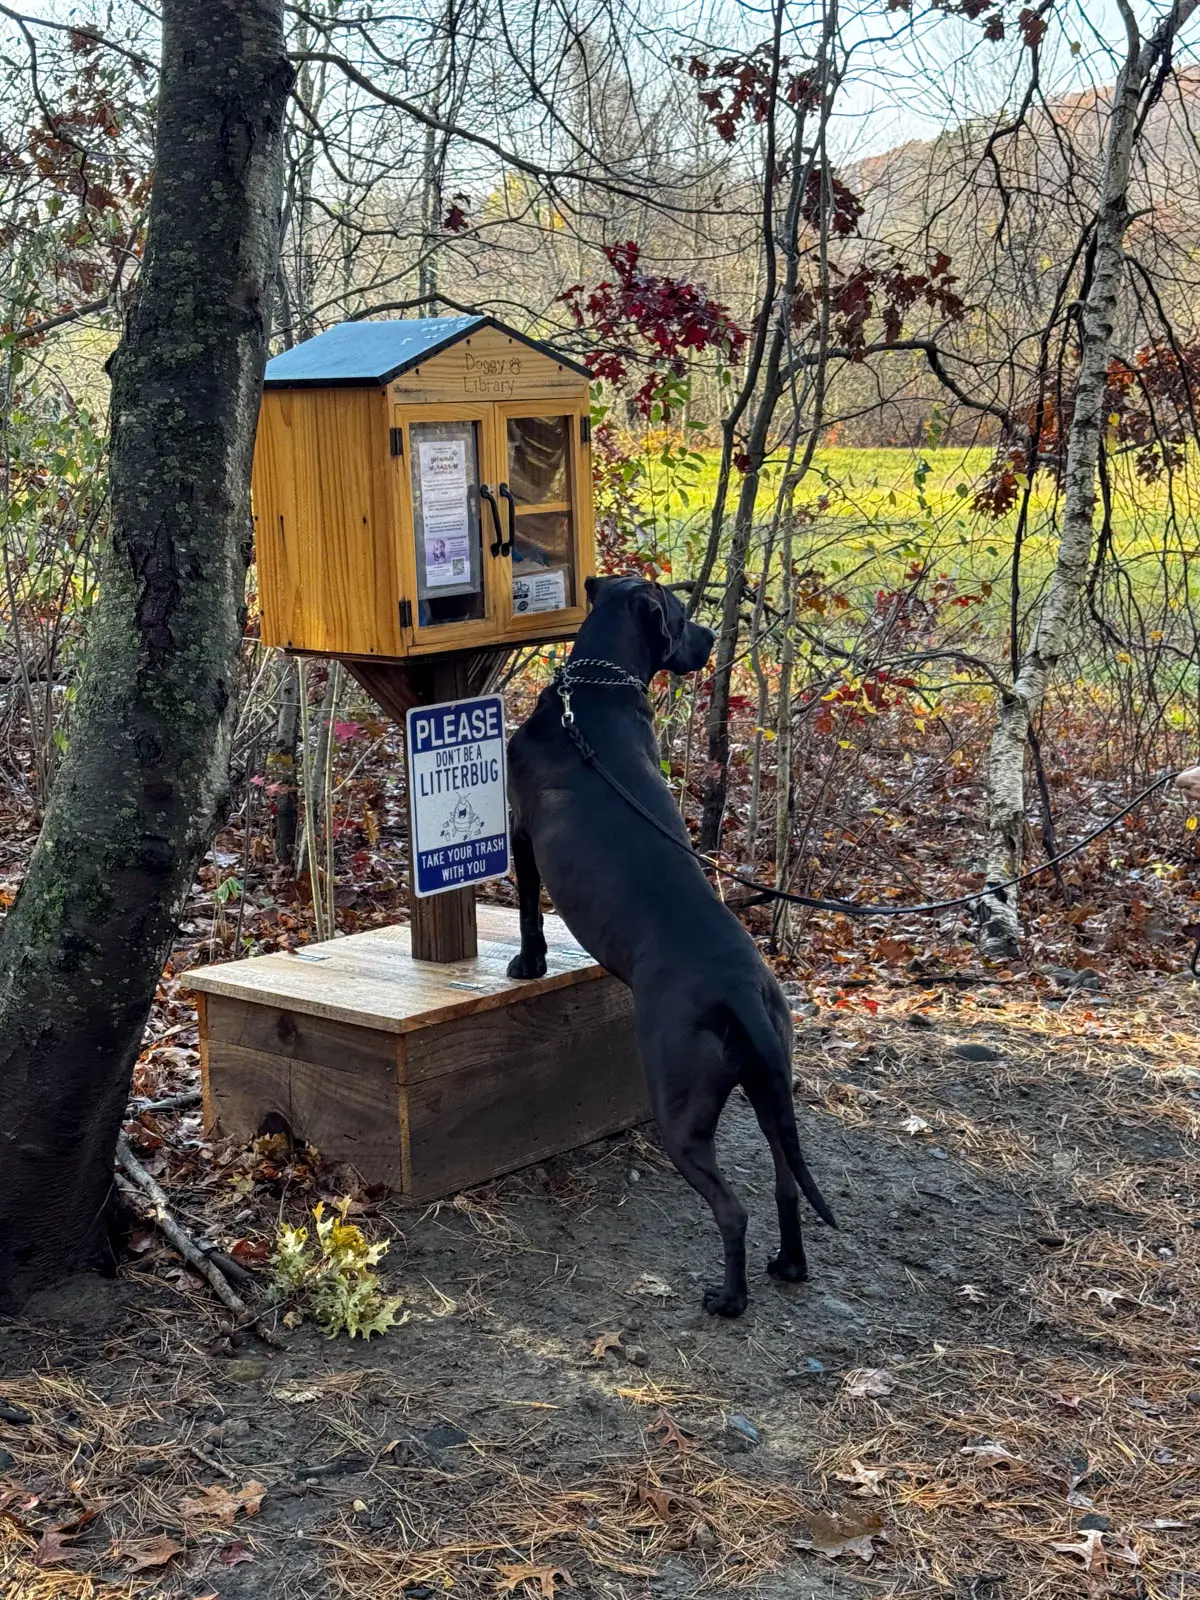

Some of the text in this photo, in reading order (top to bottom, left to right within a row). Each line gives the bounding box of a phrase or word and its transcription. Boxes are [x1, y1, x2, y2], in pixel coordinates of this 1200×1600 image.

[465, 353, 505, 374] Doggy
[463, 376, 514, 398] Library
[416, 707, 499, 749] PLEASE
[436, 744, 482, 767] DON'T BE A
[420, 758, 498, 797] LITTERBUG
[421, 837, 505, 869] TAKE YOUR TRASH
[441, 859, 486, 881] WITH YOU
